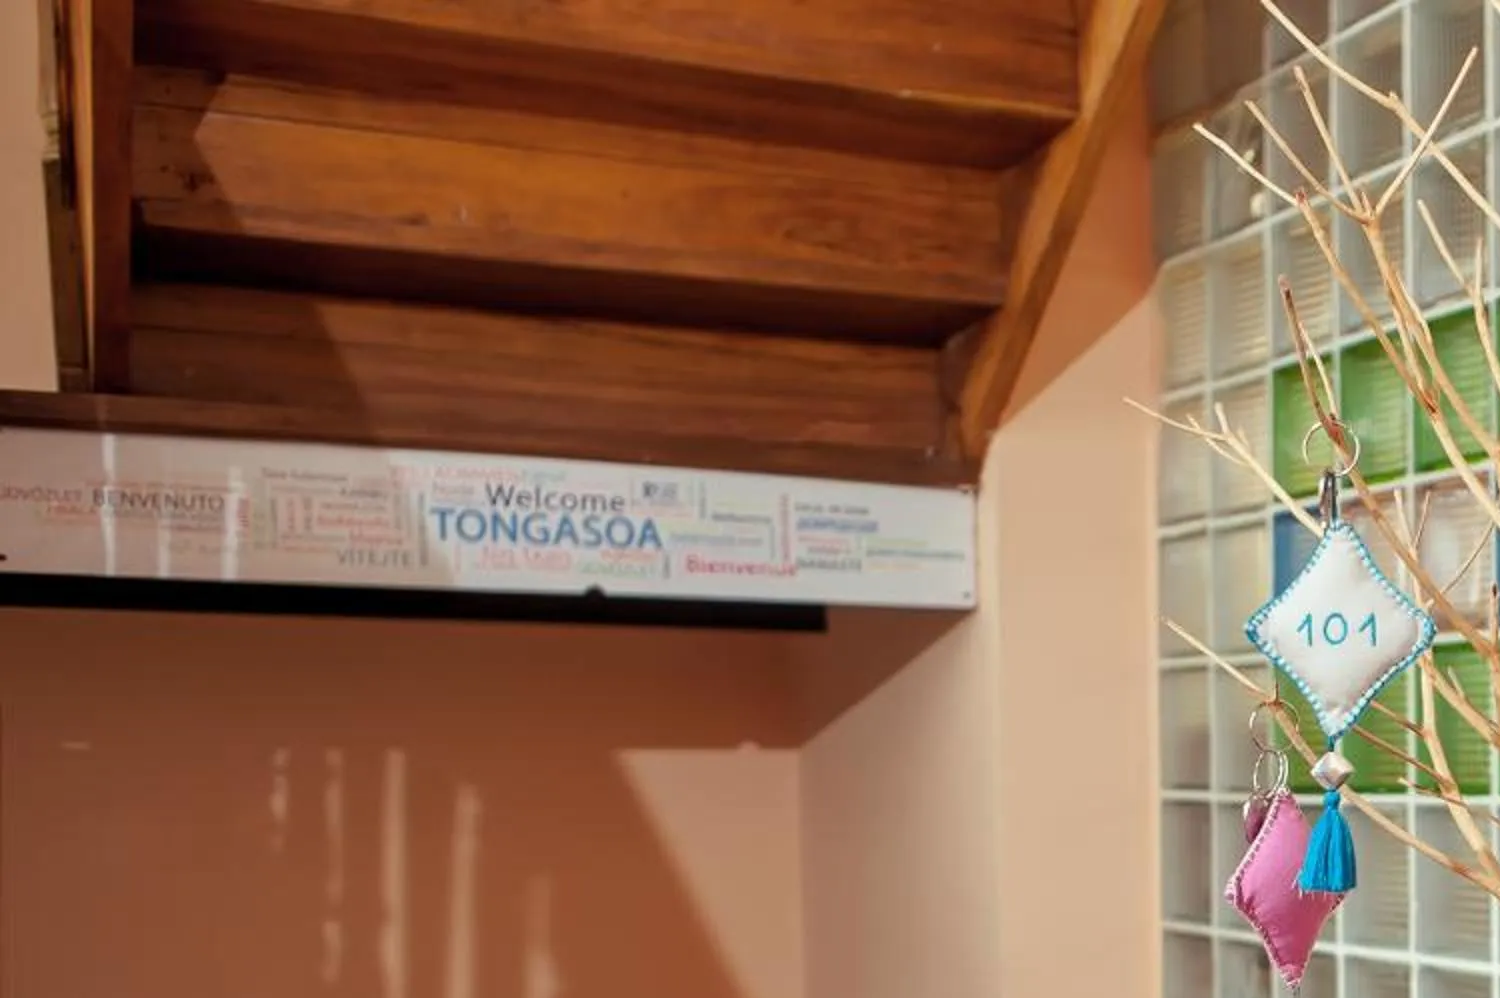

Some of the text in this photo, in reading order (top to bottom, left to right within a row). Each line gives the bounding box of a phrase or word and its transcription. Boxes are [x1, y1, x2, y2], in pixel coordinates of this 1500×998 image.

[92, 487, 226, 512] BENVENUTO
[485, 482, 626, 513] Welcome
[430, 505, 664, 549] TONGASOA
[1295, 612, 1378, 648] 101
